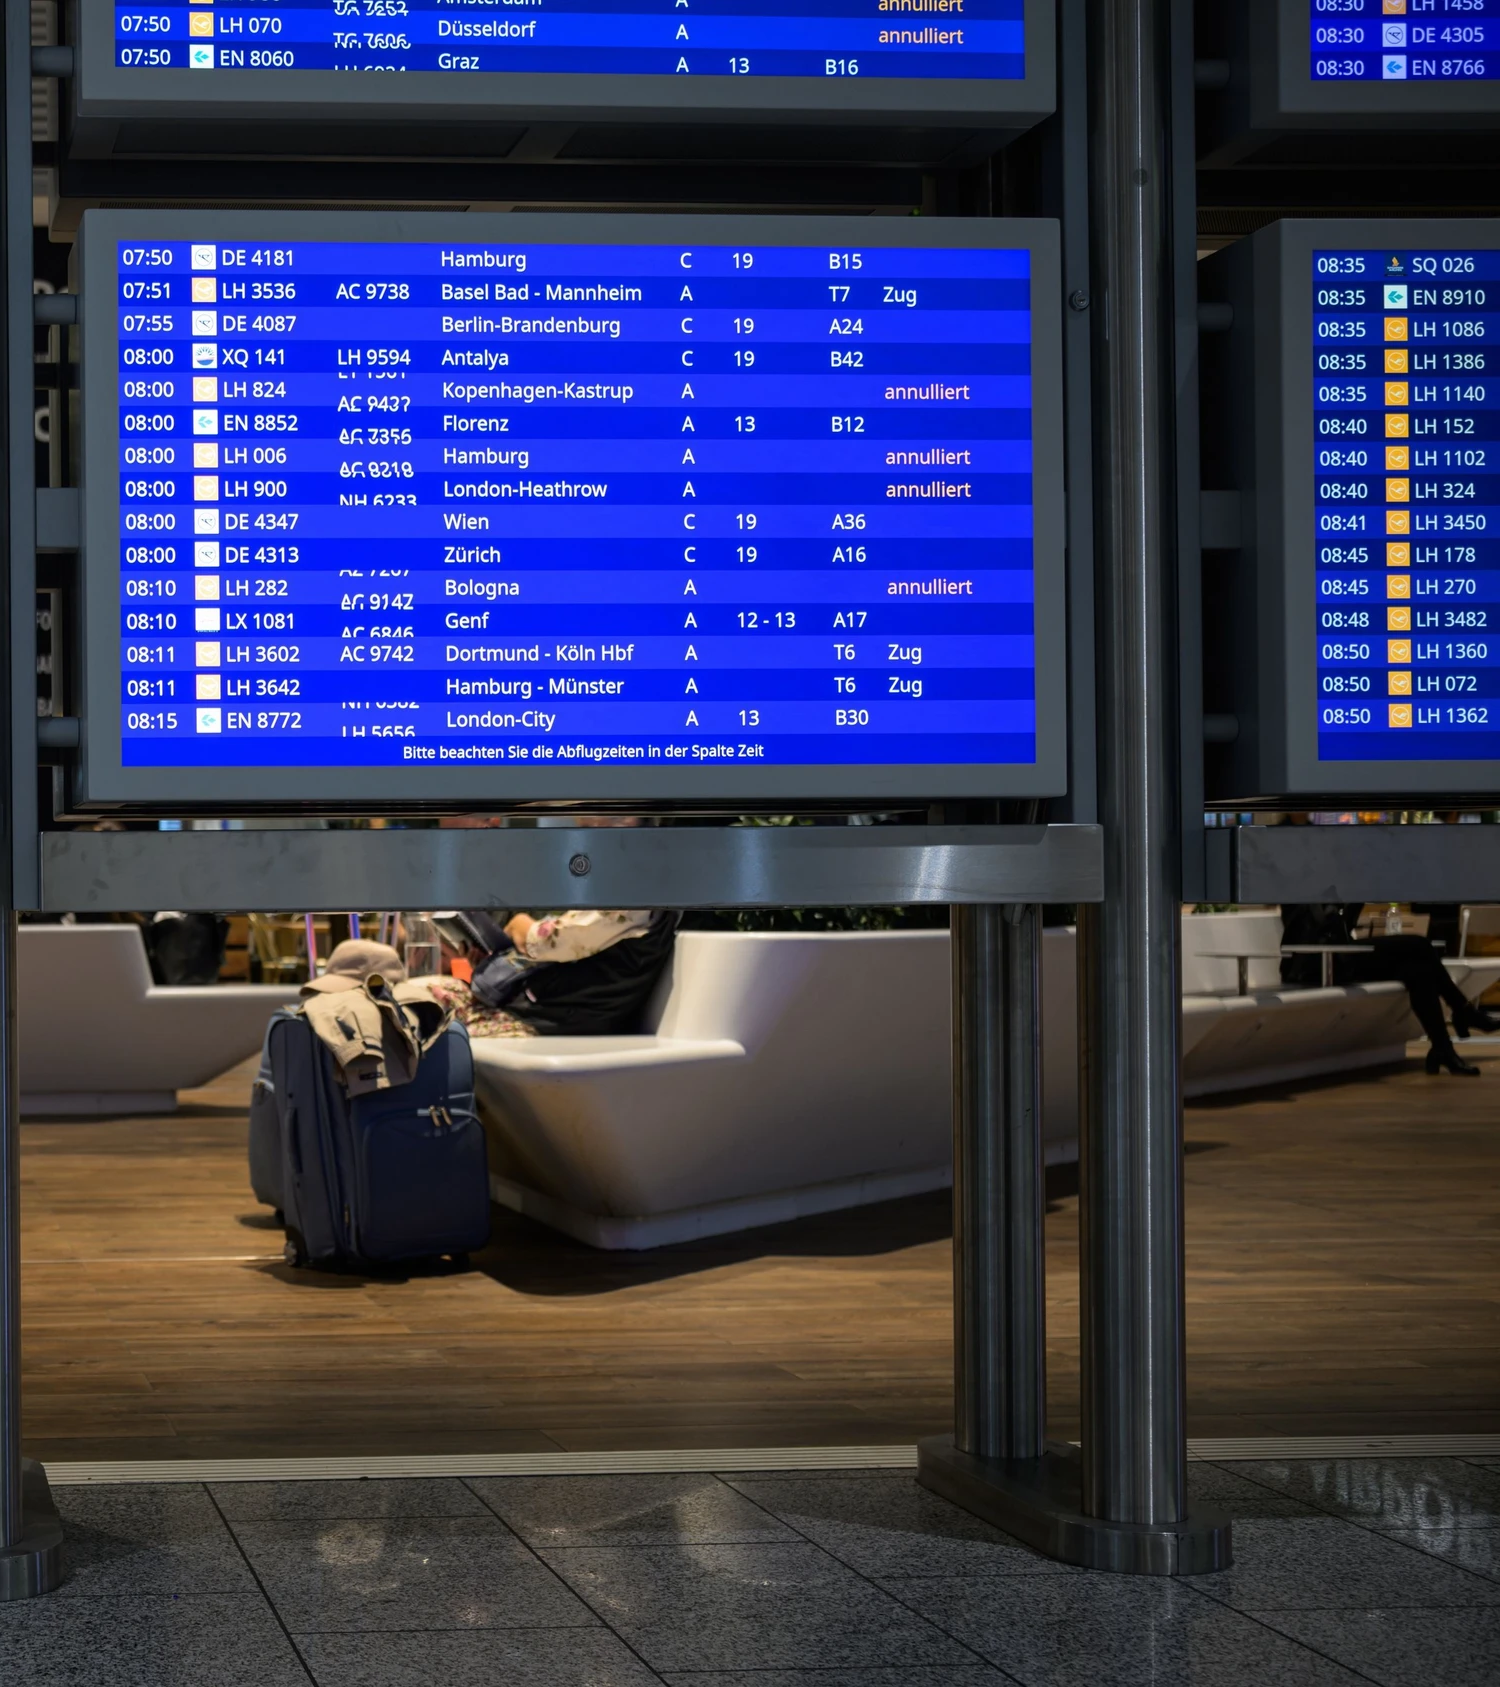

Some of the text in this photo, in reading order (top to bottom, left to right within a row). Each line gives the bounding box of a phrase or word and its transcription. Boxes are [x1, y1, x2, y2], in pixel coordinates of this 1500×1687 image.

[1317, 0, 1483, 11] 08:30 LH 1458
[121, 16, 963, 44] 07:50 LH 070 Düsseldorf annulliert
[1317, 28, 1483, 43] 08:30 DE 4305
[122, 49, 858, 75] 07:50 EN 8060 Graz 13 B16
[1317, 60, 1484, 75] 08:30 EN 8766
[1318, 258, 1474, 275] 08:35 SQ 026
[124, 283, 916, 307] 07:51 LH 3536 AC 9738 Basel Bad Mannheim T7 Zug
[124, 349, 863, 370] 08:00 XQ 141 LH 9594 Antalya 19 B42
[1319, 386, 1485, 401] 08:35 LH 1140
[125, 448, 971, 468] 08:00 LH 006 Hamburg annulliert
[1321, 515, 1486, 530] 08:41 LH 3450
[126, 546, 866, 563] 08:00 DE 4313 Zürich 19 A16
[127, 612, 867, 629] 08:10 LX 1081 Genf 12 13 A17
[1322, 612, 1486, 627] 08:48 LH 3482
[128, 710, 868, 731] 08:15 EN 8772 London-City 13 B30
[1323, 708, 1488, 724] 08:50 LH 1362
[404, 744, 764, 761] Bitte beachten Sie die Abflugzeiten in der Spalte Zeit
